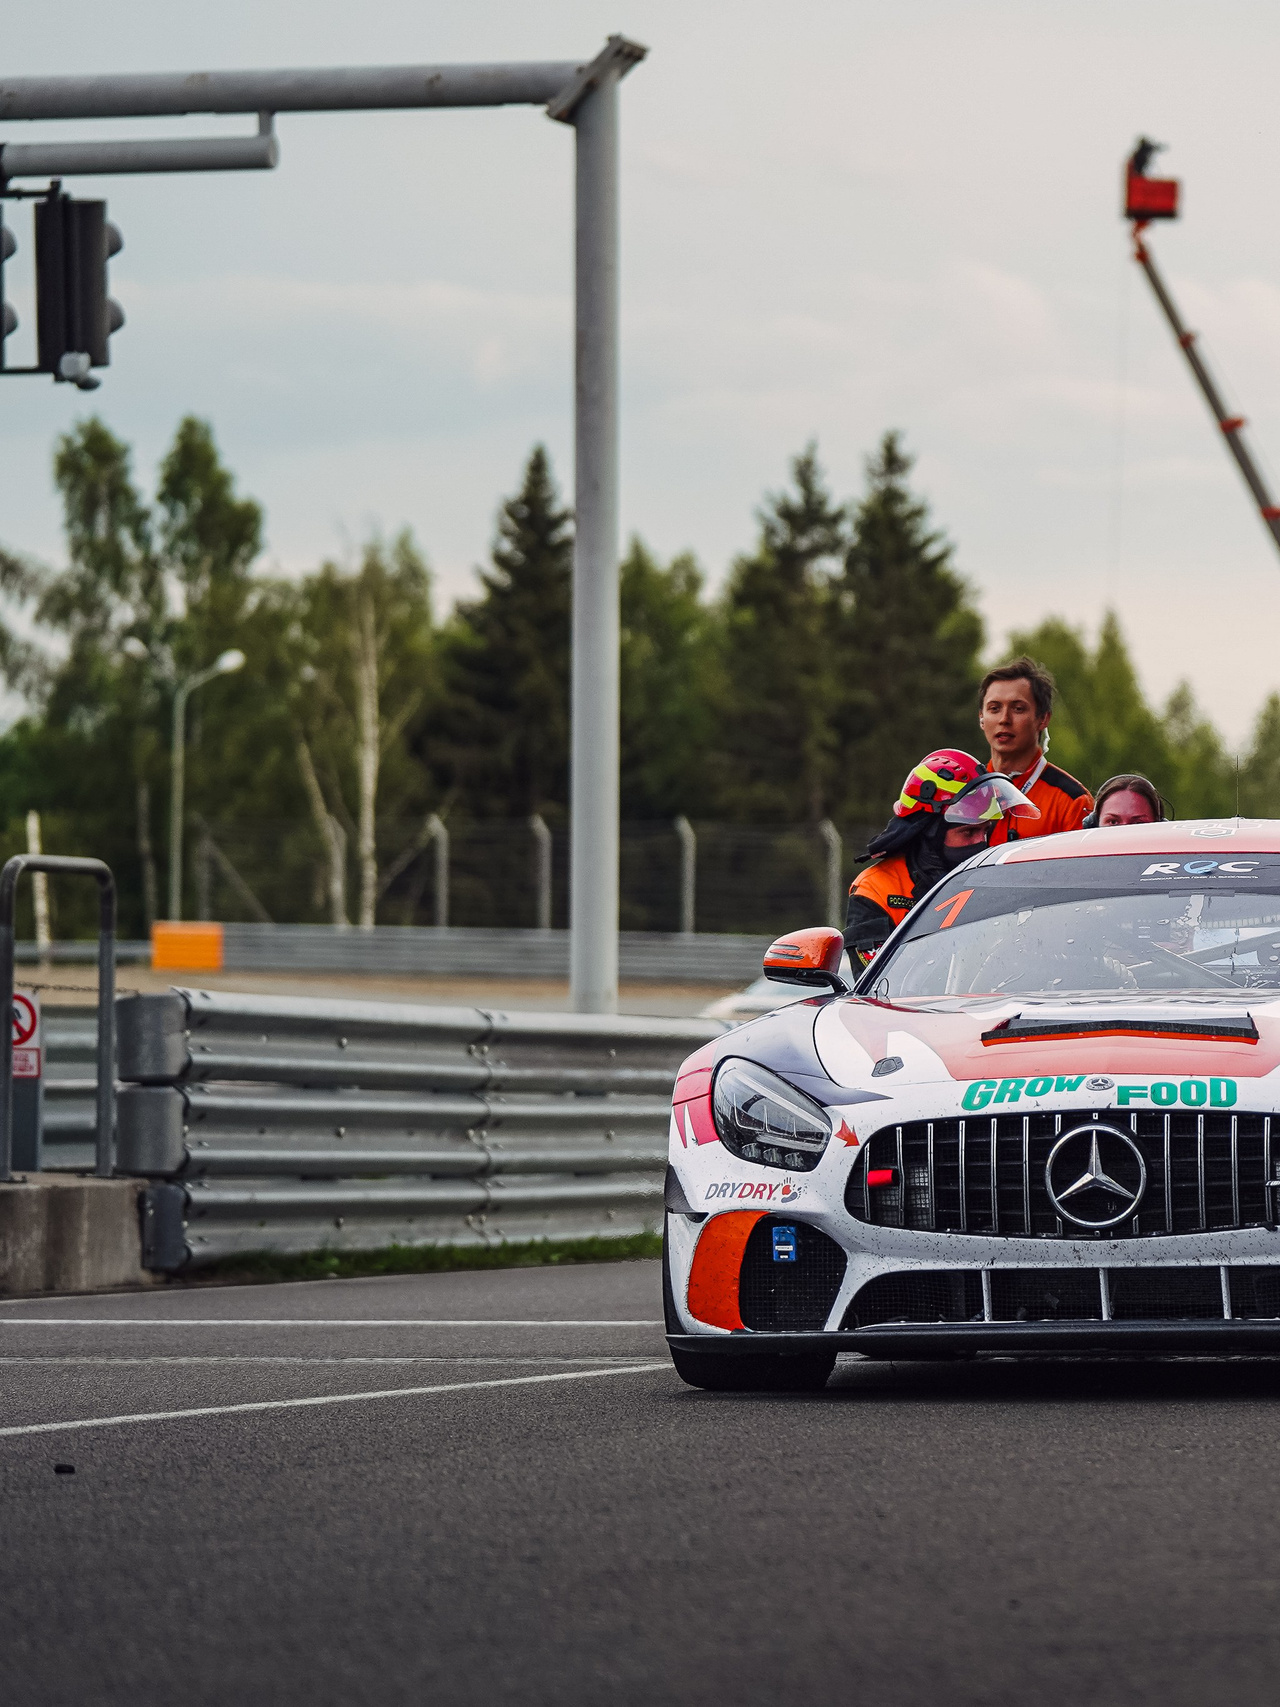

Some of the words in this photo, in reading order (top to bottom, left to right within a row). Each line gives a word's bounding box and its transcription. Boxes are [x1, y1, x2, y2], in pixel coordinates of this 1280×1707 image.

[934, 888, 975, 929] 1
[961, 1075, 1087, 1111] GROW
[1117, 1077, 1238, 1107] FOOD
[704, 1182, 781, 1200] DRYDRY
